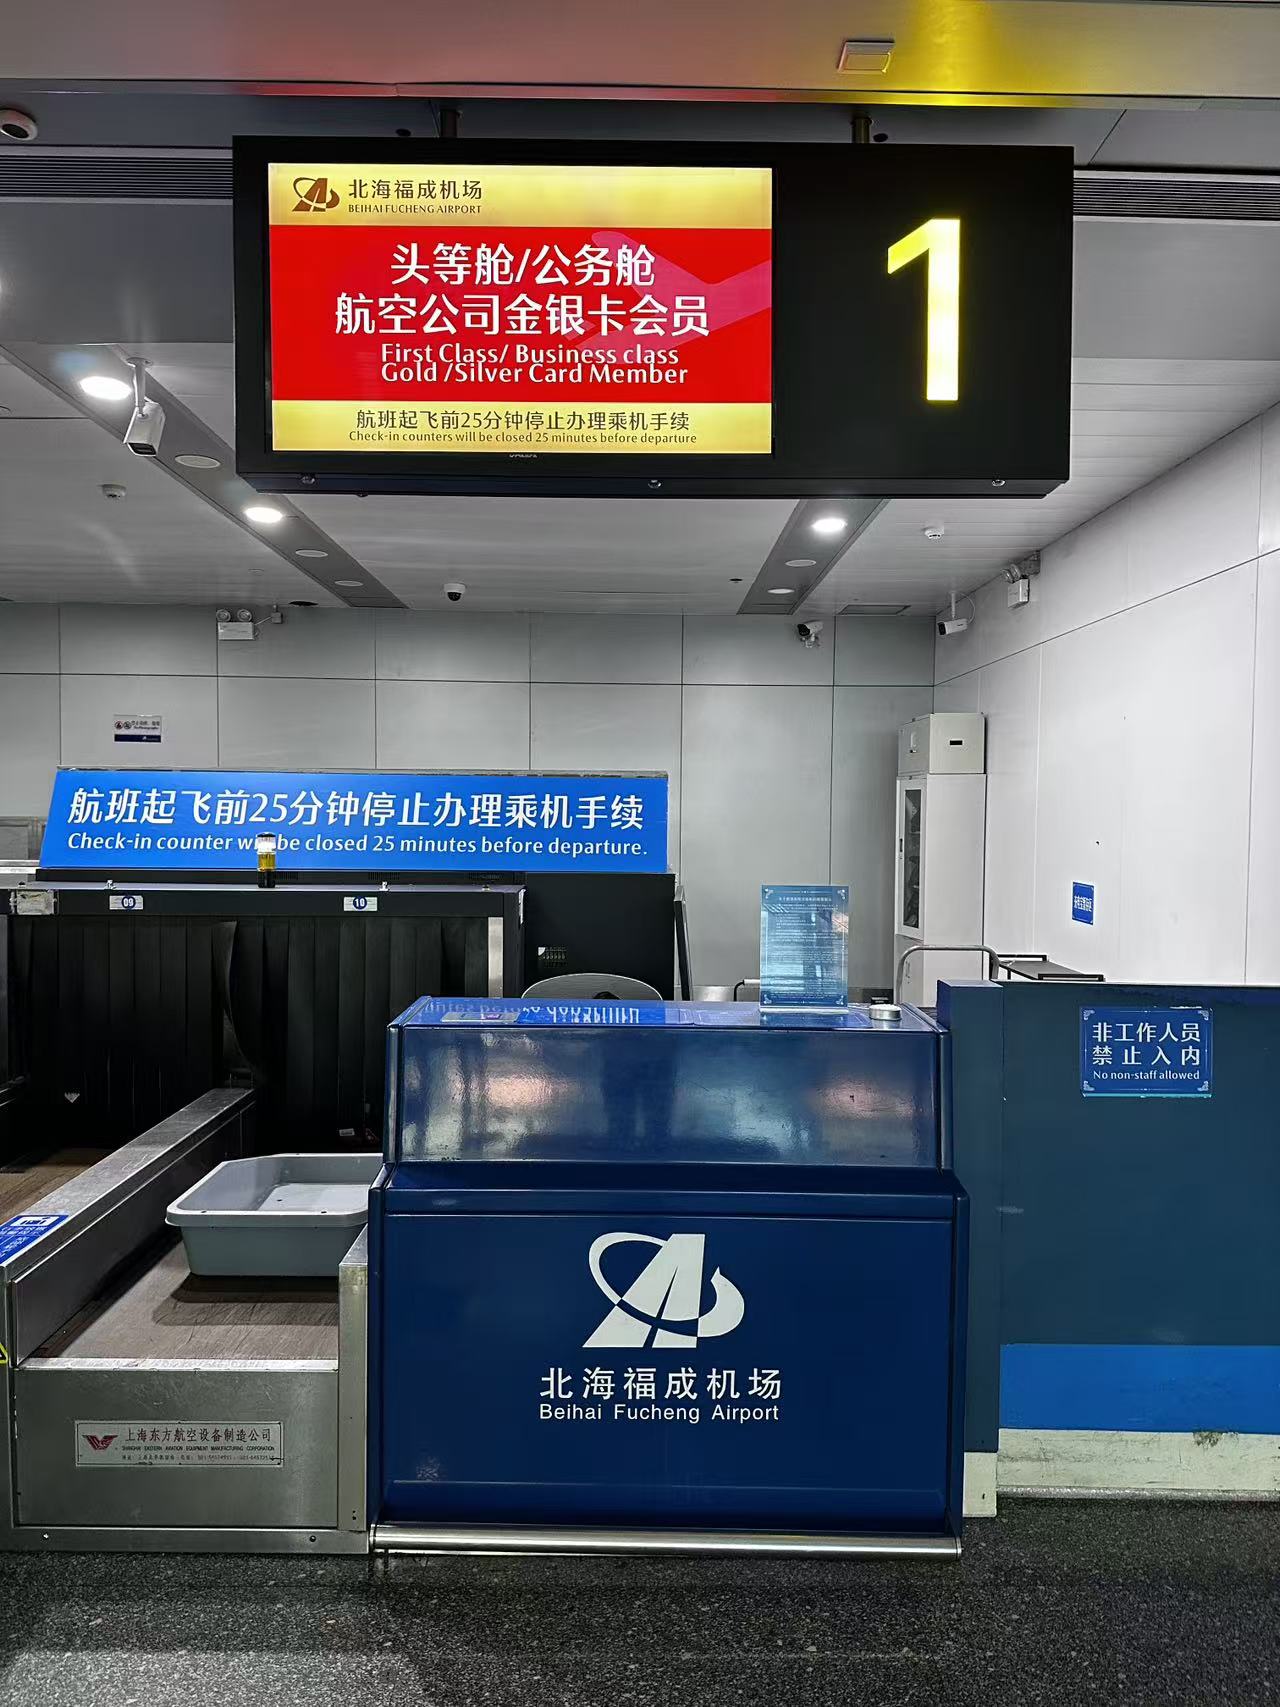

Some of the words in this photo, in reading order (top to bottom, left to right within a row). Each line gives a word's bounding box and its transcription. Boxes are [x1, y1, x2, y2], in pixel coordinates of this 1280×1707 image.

[348, 179, 482, 200] 北海福成机场
[348, 204, 383, 213] BEIHAI
[385, 204, 435, 214] FUCHENG
[437, 205, 482, 214] AIRPORT
[390, 243, 656, 287] 头等舱/公务舱
[335, 292, 710, 337] 航空公司金银卡会员
[888, 218, 961, 401] 1
[381, 344, 433, 363] First
[439, 344, 509, 364] Class/
[515, 345, 617, 364] Business
[623, 346, 679, 364] class
[381, 362, 437, 383] Gold
[444, 362, 522, 384] /Silver
[529, 363, 582, 383] Card
[589, 363, 688, 384] Member
[356, 409, 690, 431] 航班起飞前25分钟停止办理乘机手续
[349, 430, 399, 441] Check-in
[402, 431, 453, 442] counters
[455, 431, 476, 442] will
[479, 431, 493, 442] be
[495, 431, 533, 443] closed
[535, 432, 549, 443] 25
[551, 432, 598, 443] minutes
[600, 432, 638, 443] before
[640, 433, 697, 445] departure
[67, 787, 644, 830] 航班起飞前25分钟停止办理乘机手续
[67, 832, 152, 850] Check-in
[156, 833, 233, 850] counter
[277, 833, 300, 851] be
[305, 834, 368, 852] closed
[373, 835, 396, 852] 25
[400, 836, 477, 853] minutes
[481, 836, 544, 854] before
[548, 838, 648, 858] departure.
[122, 897, 135, 907] 09
[354, 897, 366, 907] 10
[1092, 1022, 1201, 1042] 非工作人员
[1092, 1045, 1201, 1066] 禁止入内
[1093, 1070, 1108, 1080] No
[1110, 1070, 1157, 1080] non-staff
[1159, 1070, 1200, 1080] allowed
[540, 1367, 782, 1400] 北海福成机场
[539, 1404, 602, 1420] Beihai
[614, 1404, 700, 1424] Fucheng
[711, 1404, 779, 1423] Airport
[125, 1427, 272, 1443] 上海东方航空设备制造公司
